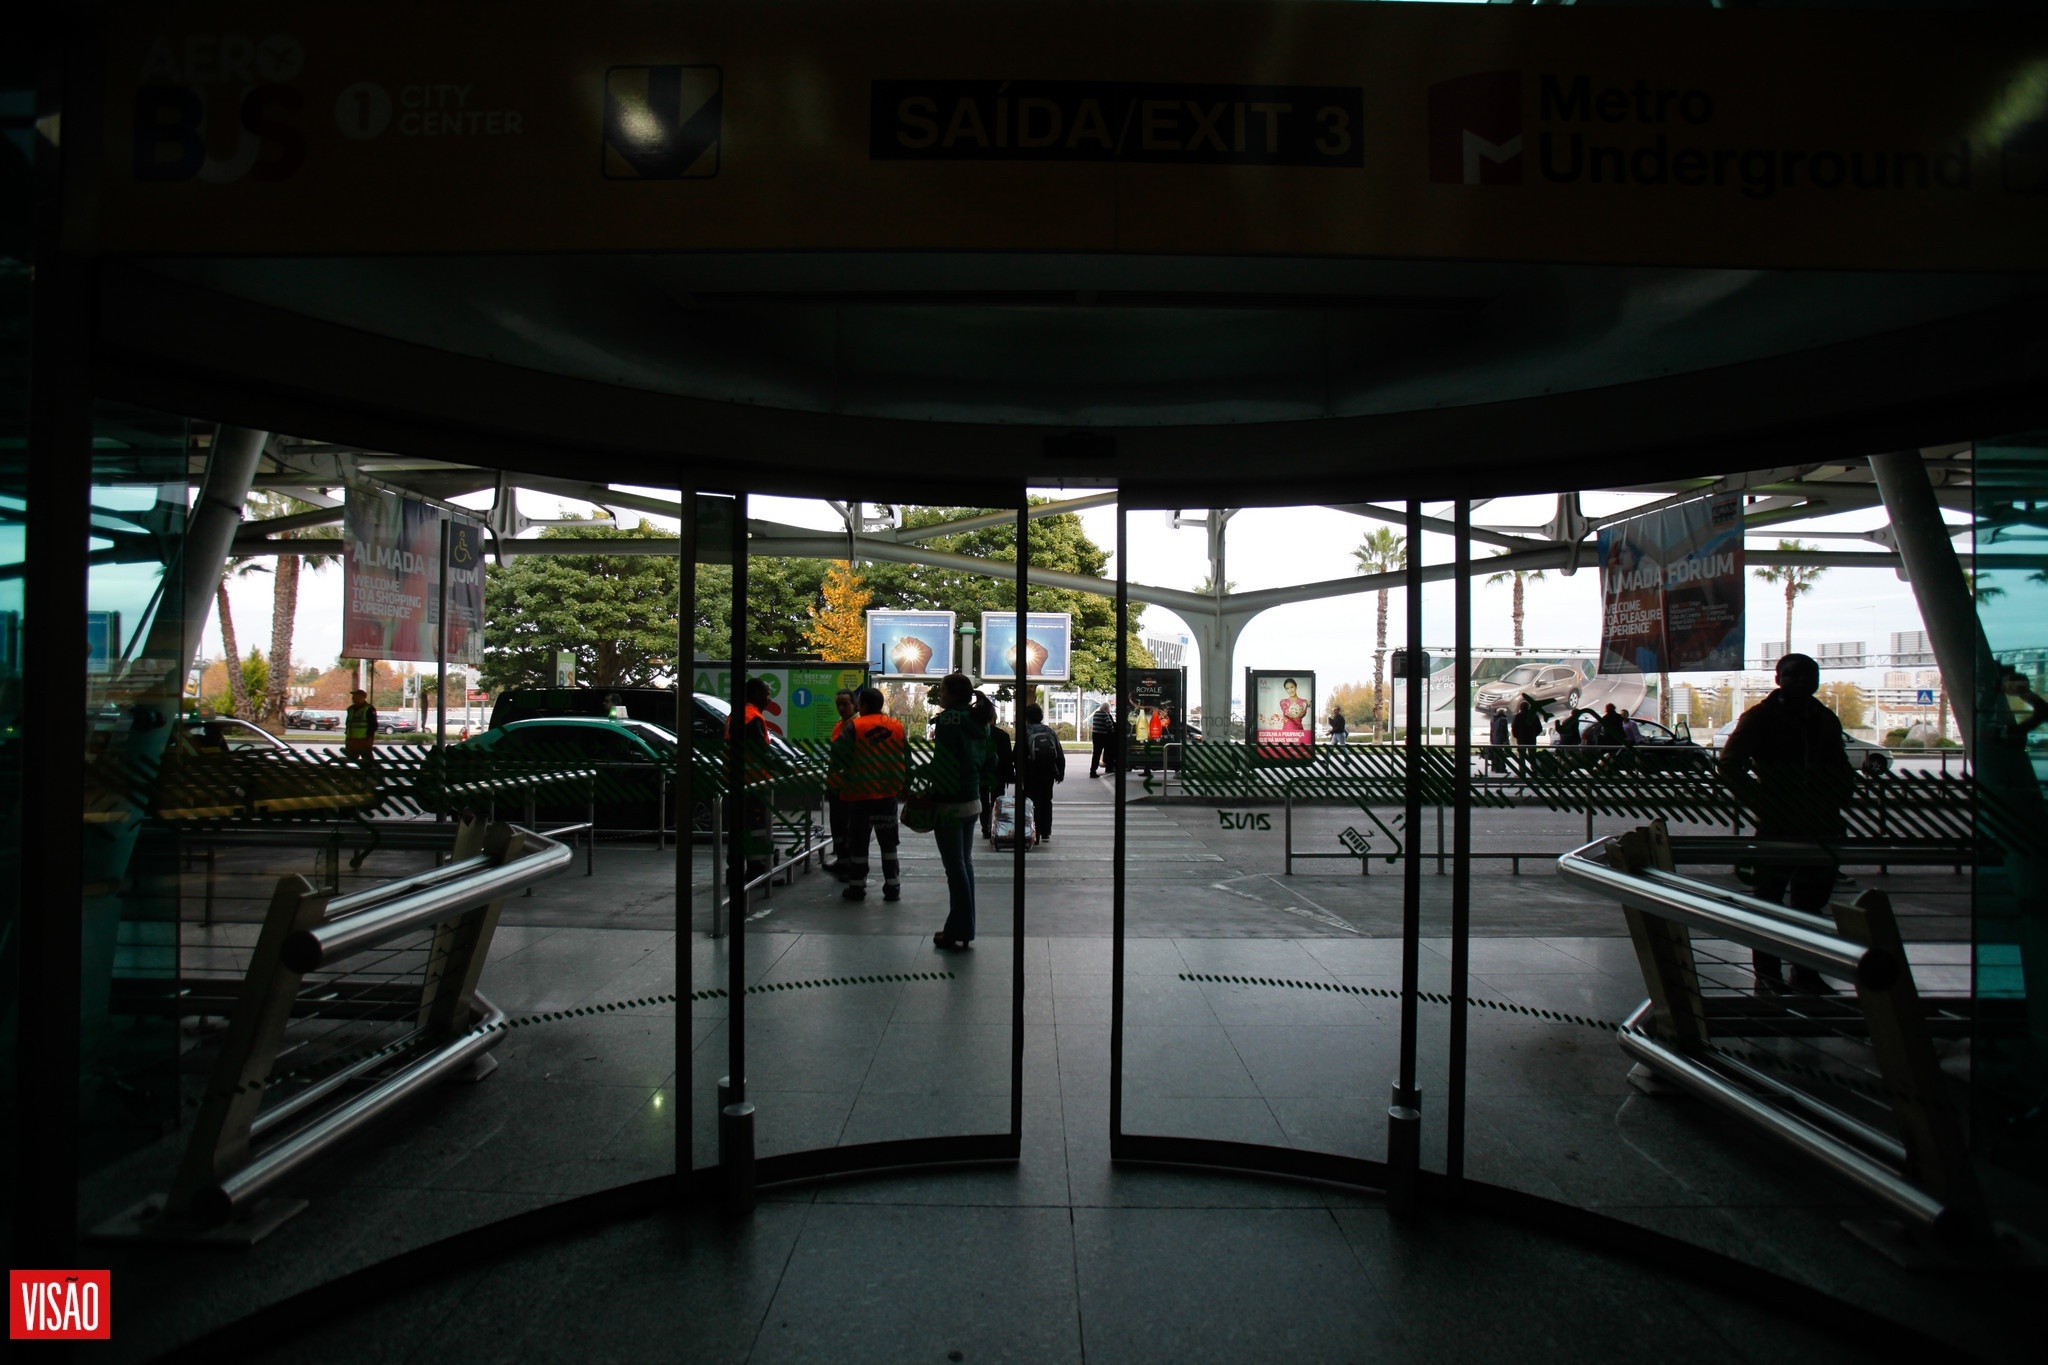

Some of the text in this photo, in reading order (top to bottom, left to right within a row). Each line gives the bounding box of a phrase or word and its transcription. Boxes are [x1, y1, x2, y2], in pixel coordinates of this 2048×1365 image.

[137, 32, 305, 83] AERO
[400, 84, 472, 109] CITY
[896, 80, 1352, 156] SAÍDA/EXIT 3
[1539, 74, 1714, 125] Metro
[133, 84, 306, 183] BUS
[399, 111, 524, 137] CENTER
[1539, 133, 1972, 196] Underground
[352, 540, 480, 587] ALMADA FRUM
[352, 573, 400, 593] WELCOME
[1606, 552, 1735, 596] ALMADA FORUM
[352, 586, 422, 608] TO A SHOPPING
[1620, 608, 1662, 625] PLEASURE
[1136, 686, 1163, 694] ROYALE
